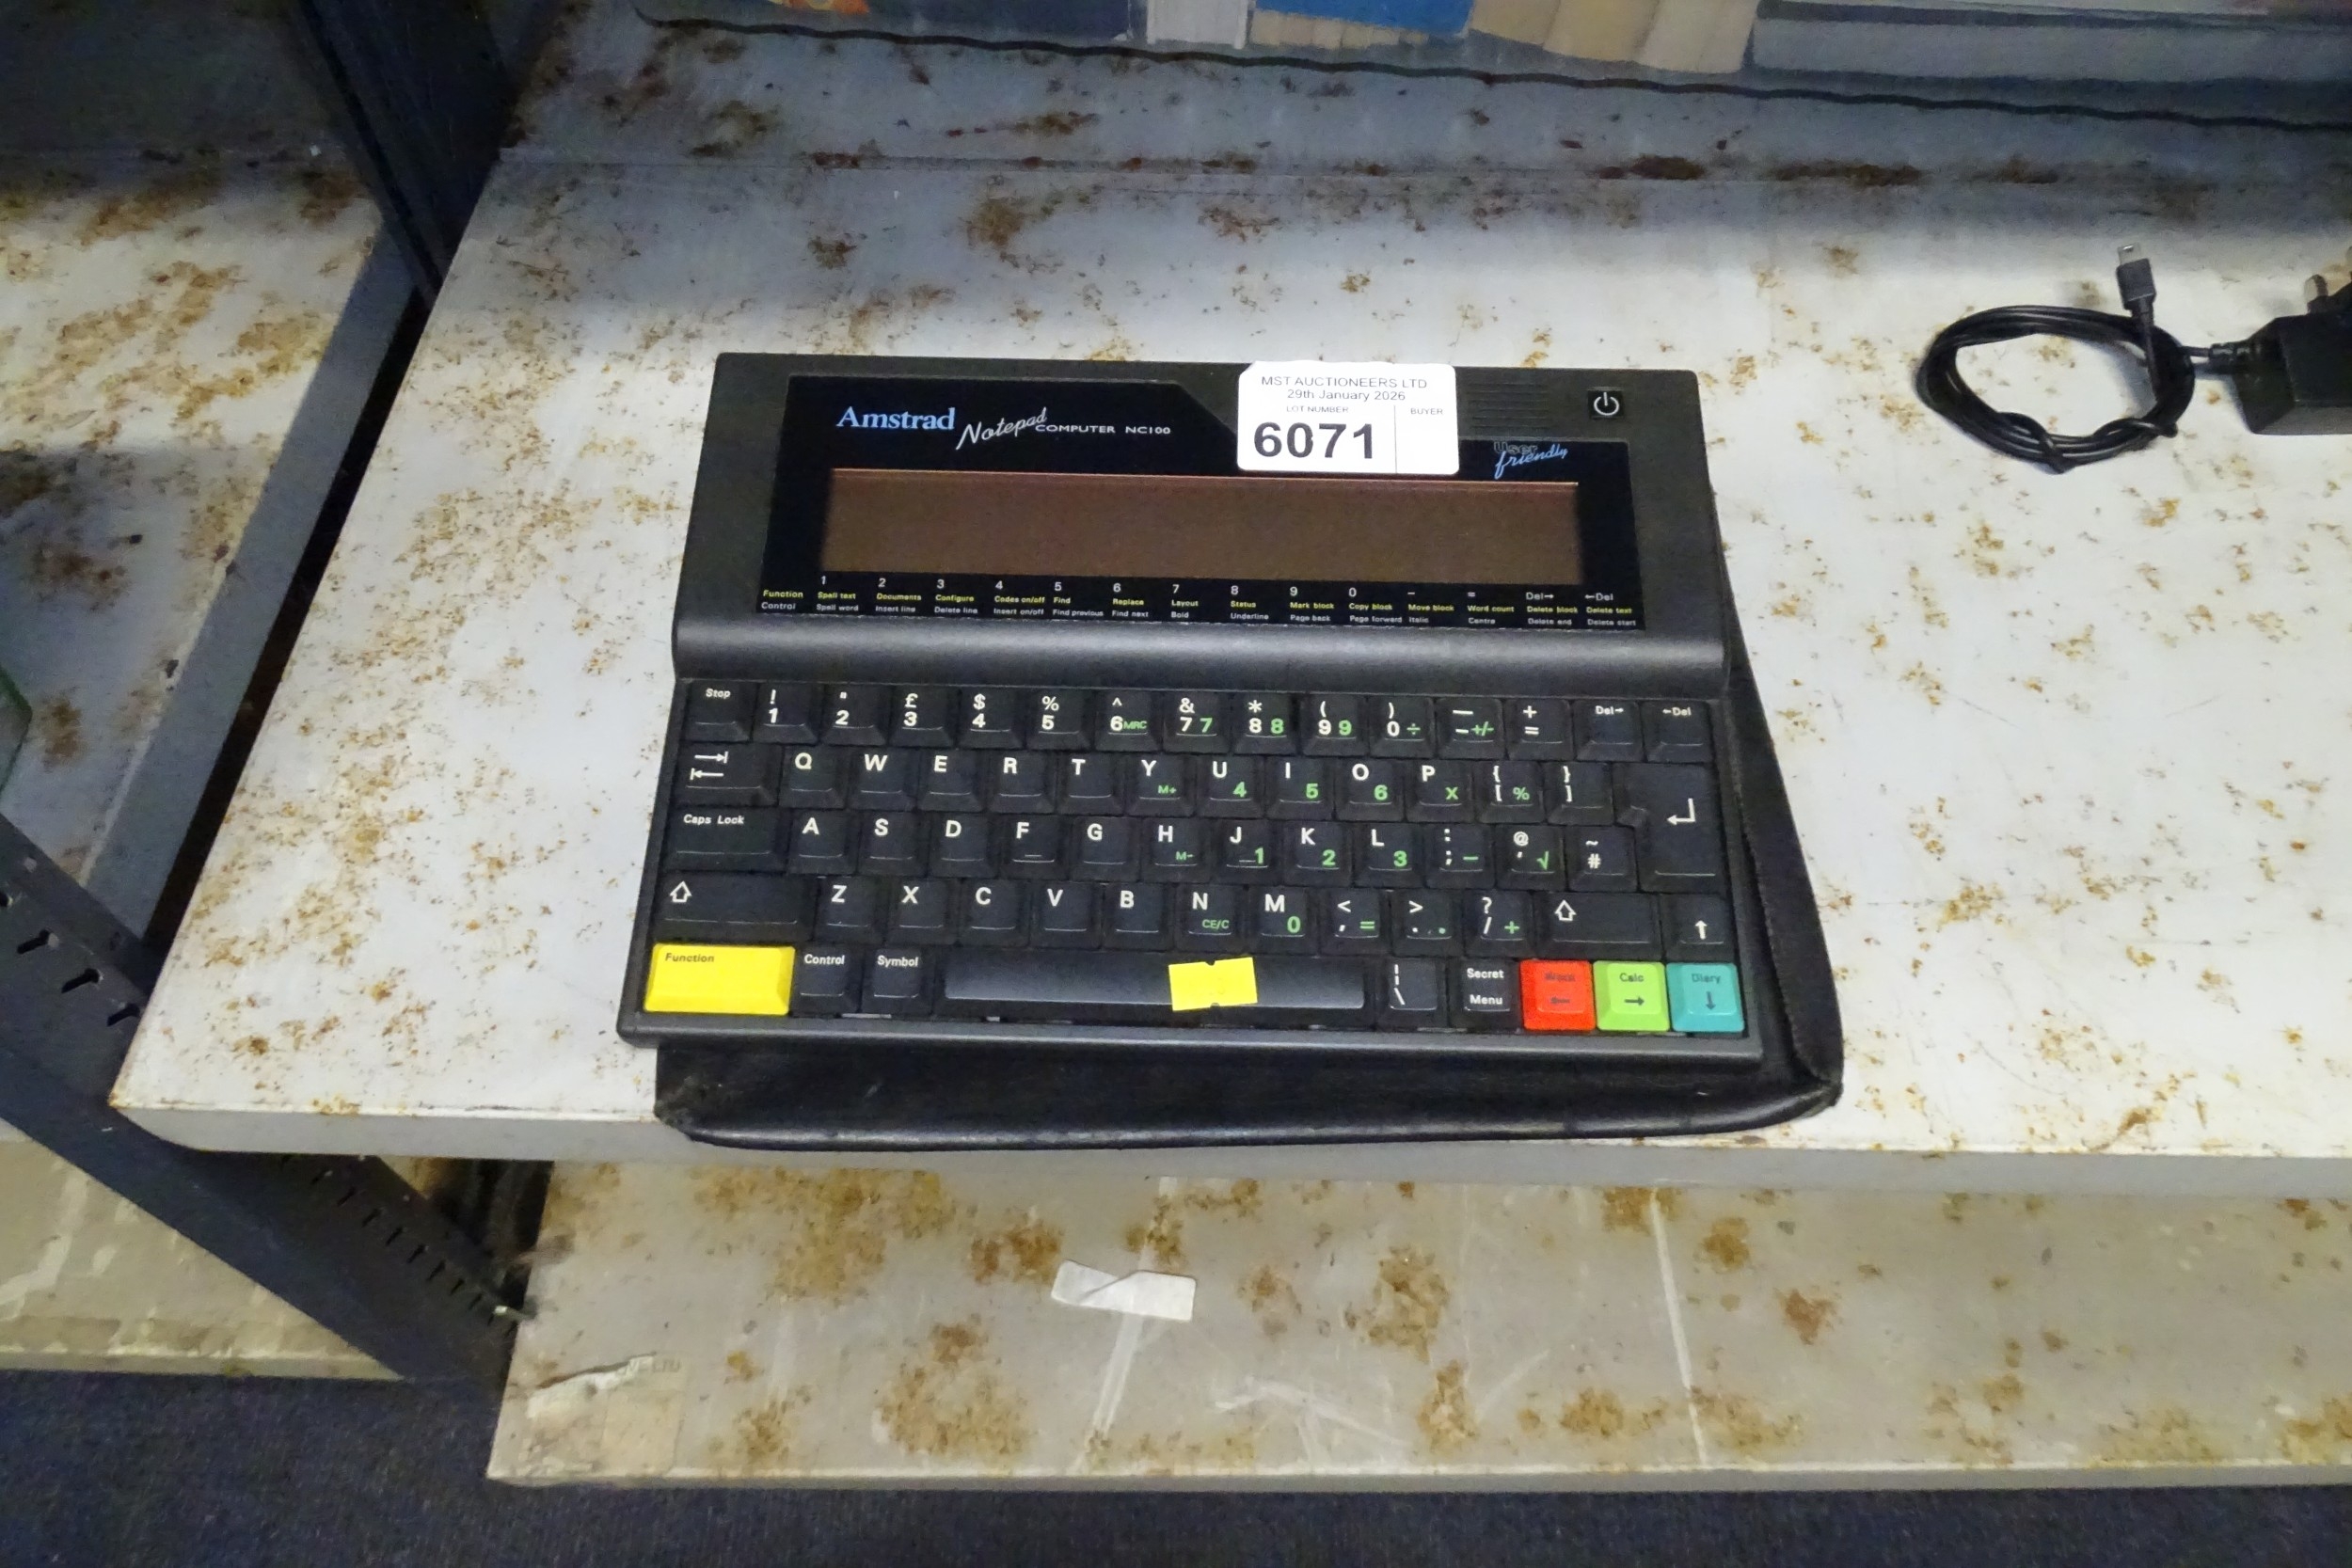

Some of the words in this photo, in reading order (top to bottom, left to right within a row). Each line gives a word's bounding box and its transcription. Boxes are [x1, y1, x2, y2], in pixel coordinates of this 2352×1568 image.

[1262, 376, 1290, 387] MST
[1295, 376, 1397, 388] AUCTIONEERS
[1402, 378, 1427, 388] LTD
[1287, 388, 1314, 399] 29th
[1318, 389, 1371, 402] January
[1375, 390, 1406, 401] 2026
[835, 405, 956, 430] Amstrad
[955, 406, 1047, 451] Notepad
[1035, 424, 1116, 434] COMPUTER
[1125, 425, 1171, 435] NC100
[1253, 421, 1373, 459] 6071
[1494, 443, 1568, 480] friendly
[820, 575, 827, 585] 1
[878, 578, 886, 588] 2
[936, 578, 945, 589] 3
[994, 579, 1004, 590] 4
[1054, 581, 1062, 592] 5
[1112, 582, 1121, 593] 6
[763, 589, 803, 599] Function
[1172, 583, 1180, 594] 7
[1231, 585, 1239, 595] 8
[1289, 586, 1298, 596] 9
[1348, 587, 1358, 597] 0
[1525, 592, 1544, 600] Del
[876, 593, 922, 601] Documents
[935, 594, 975, 603] Configure
[1171, 599, 1199, 608] Layout
[1596, 593, 1613, 601] Del
[761, 601, 796, 610] Control
[706, 689, 731, 699] Stop
[770, 689, 776, 705] !
[904, 692, 918, 708] £
[973, 693, 986, 710] $
[1041, 695, 1059, 711] %
[1179, 697, 1195, 714] &
[1596, 705, 1613, 715] Del
[768, 707, 779, 724] 1
[834, 709, 850, 725] 2
[903, 711, 918, 727] 3
[1672, 706, 1692, 717] Del
[972, 713, 986, 728] 4
[1041, 714, 1055, 731] 5
[1110, 715, 1123, 732] 6
[1122, 720, 1148, 730] MRC
[1180, 716, 1193, 732] 7
[1199, 717, 1213, 733] 7
[1248, 717, 1263, 734] 8
[1270, 718, 1284, 734] 8
[1318, 720, 1332, 736] 9
[1338, 720, 1352, 736] 9
[1386, 721, 1401, 736] 0
[794, 752, 813, 770] Q
[864, 753, 888, 771] W
[933, 754, 947, 773] E
[1003, 756, 1017, 774] R
[1072, 758, 1086, 775] T
[1141, 759, 1157, 777] Y
[1212, 761, 1228, 779] U
[1284, 762, 1291, 780] I
[1351, 763, 1370, 782] O
[1421, 765, 1436, 783] P
[1157, 784, 1177, 794] M+
[1232, 782, 1248, 798] 4
[1305, 783, 1318, 800] 5
[1374, 784, 1389, 800] 6
[683, 814, 712, 826] Caps
[717, 815, 745, 825] Lock
[802, 816, 820, 835] A
[874, 817, 889, 837] S
[945, 819, 962, 838] D
[1016, 821, 1030, 839] F
[1087, 823, 1104, 842] G
[1157, 824, 1174, 843] H
[1229, 826, 1242, 844] J
[1300, 827, 1315, 846] K
[1371, 829, 1385, 847] L
[1513, 831, 1529, 847] @
[1254, 847, 1264, 864] 1
[1322, 848, 1336, 866] 2
[1393, 850, 1407, 867] 3
[1587, 853, 1601, 869] #
[831, 884, 847, 903] Z
[901, 885, 919, 904] X
[975, 886, 992, 905] C
[1047, 888, 1063, 907] V
[1120, 890, 1135, 909] B
[1192, 892, 1209, 911] N
[1264, 894, 1285, 912] M
[1482, 896, 1493, 914] ?
[1201, 919, 1230, 930] CE/C
[1286, 915, 1301, 934] 0
[664, 952, 715, 964] Function
[804, 954, 845, 965] Control
[877, 955, 918, 968] Symbol
[1467, 968, 1504, 979] Secret
[1619, 973, 1644, 983] Calc
[1470, 994, 1503, 1005] Menu
